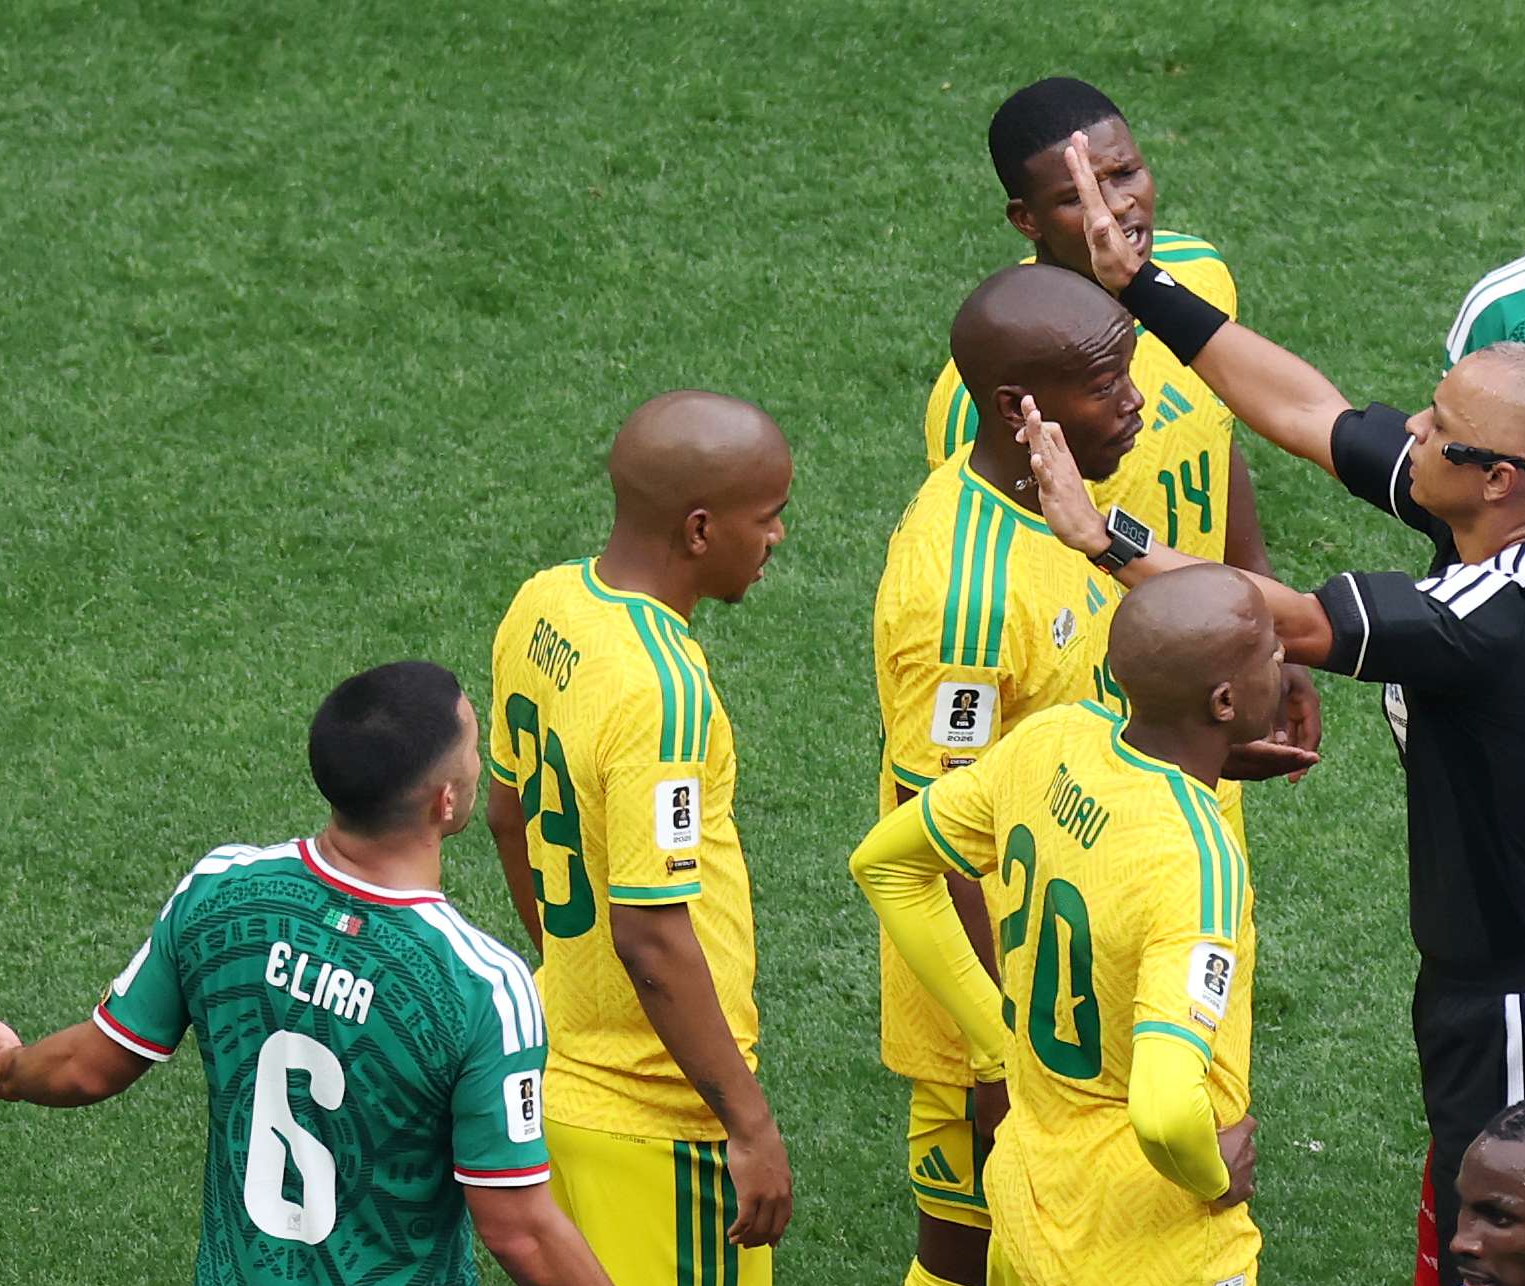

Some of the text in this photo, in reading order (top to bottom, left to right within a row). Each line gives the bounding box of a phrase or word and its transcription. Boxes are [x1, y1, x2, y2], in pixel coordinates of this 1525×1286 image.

[1116, 516, 1146, 546] 10:05
[1157, 450, 1212, 549] 14
[527, 617, 580, 693] ADAMS
[506, 693, 597, 938] 23
[1043, 762, 1111, 850] MUDAU
[1000, 823, 1103, 1080] 20
[244, 1029, 345, 1245] 6
